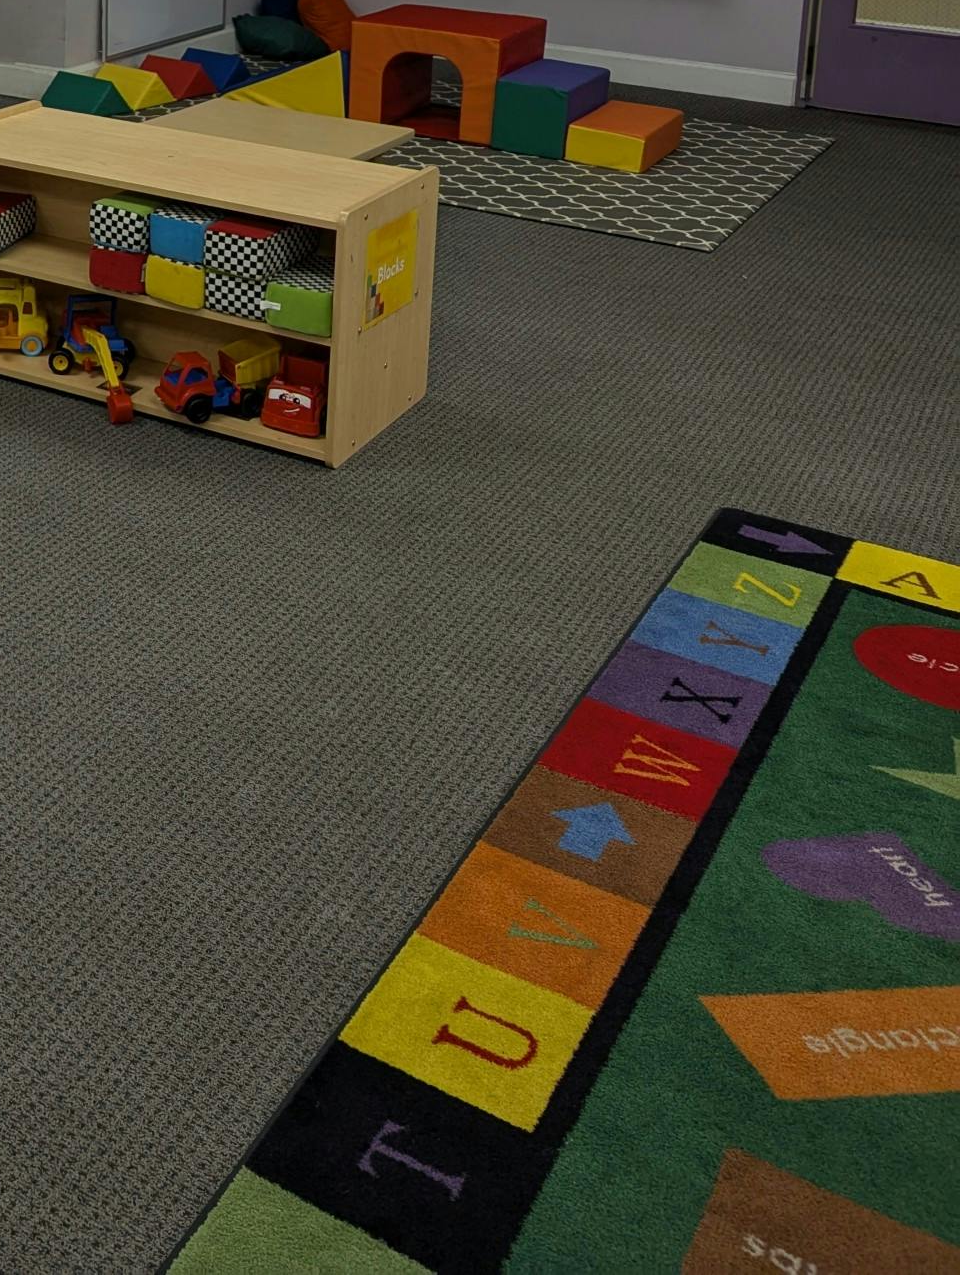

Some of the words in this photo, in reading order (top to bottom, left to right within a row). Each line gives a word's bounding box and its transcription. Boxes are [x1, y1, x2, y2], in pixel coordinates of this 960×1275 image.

[377, 257, 405, 285] Blocks
[732, 571, 803, 607] Z
[880, 570, 941, 600] A
[699, 619, 769, 656] Y
[660, 677, 741, 724] X
[613, 734, 702, 788] W
[868, 845, 954, 907] heart
[507, 899, 599, 951] V
[432, 996, 539, 1070] U
[802, 1027, 960, 1059] ctangle
[357, 1119, 468, 1200] T
